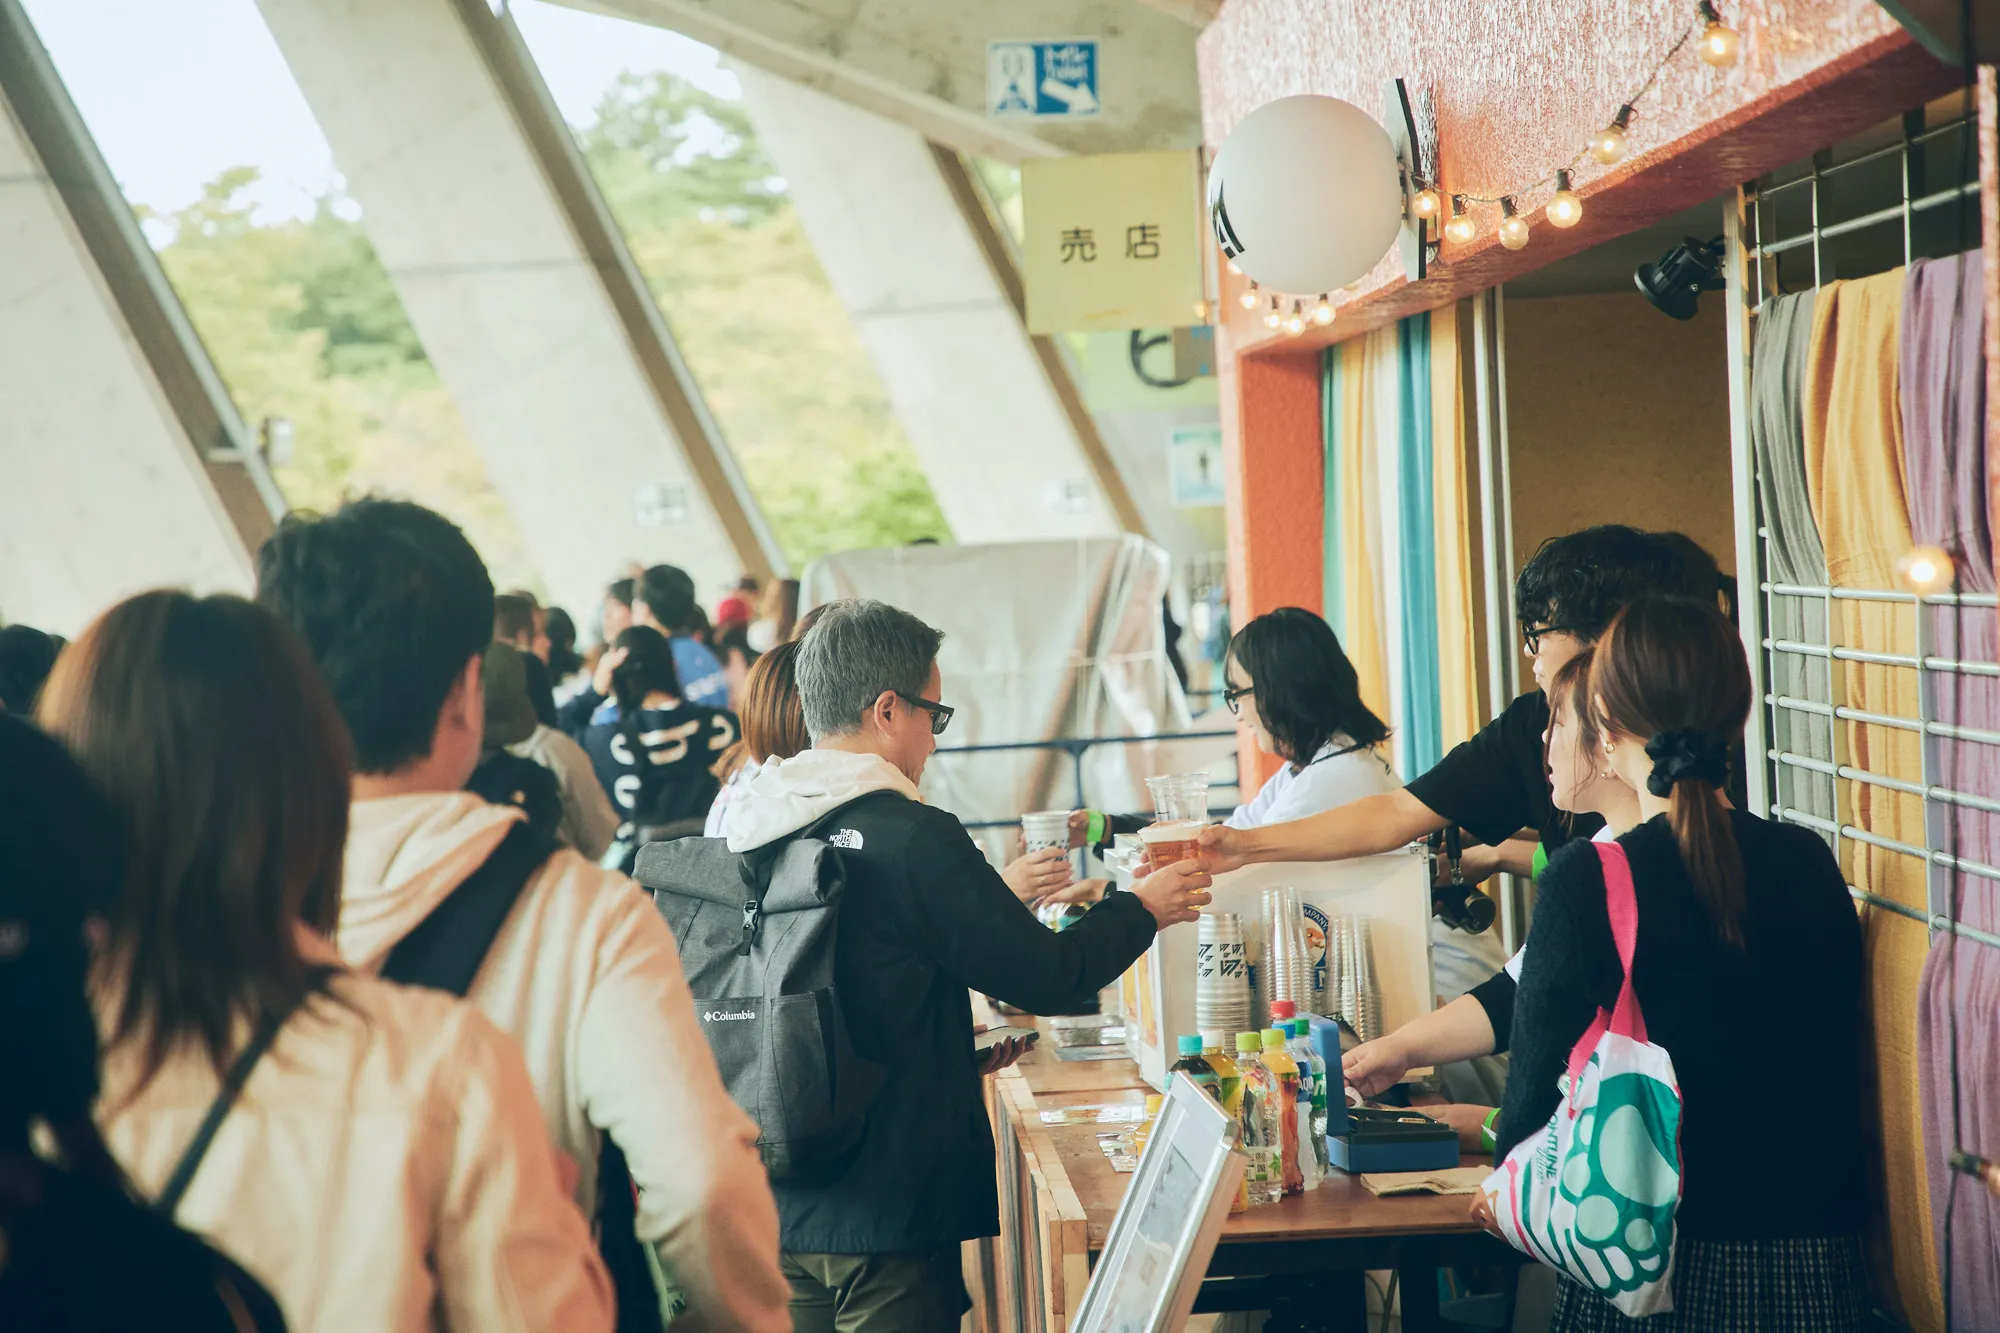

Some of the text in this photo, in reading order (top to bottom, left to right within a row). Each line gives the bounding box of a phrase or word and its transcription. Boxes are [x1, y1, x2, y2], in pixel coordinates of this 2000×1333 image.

[1061, 223, 1160, 264] 売店
[829, 834, 851, 842] NORTH
[1303, 908, 1329, 930] MPANY
[712, 1010, 756, 1021] Columbia
[1546, 1112, 1559, 1180] ONTLINE
